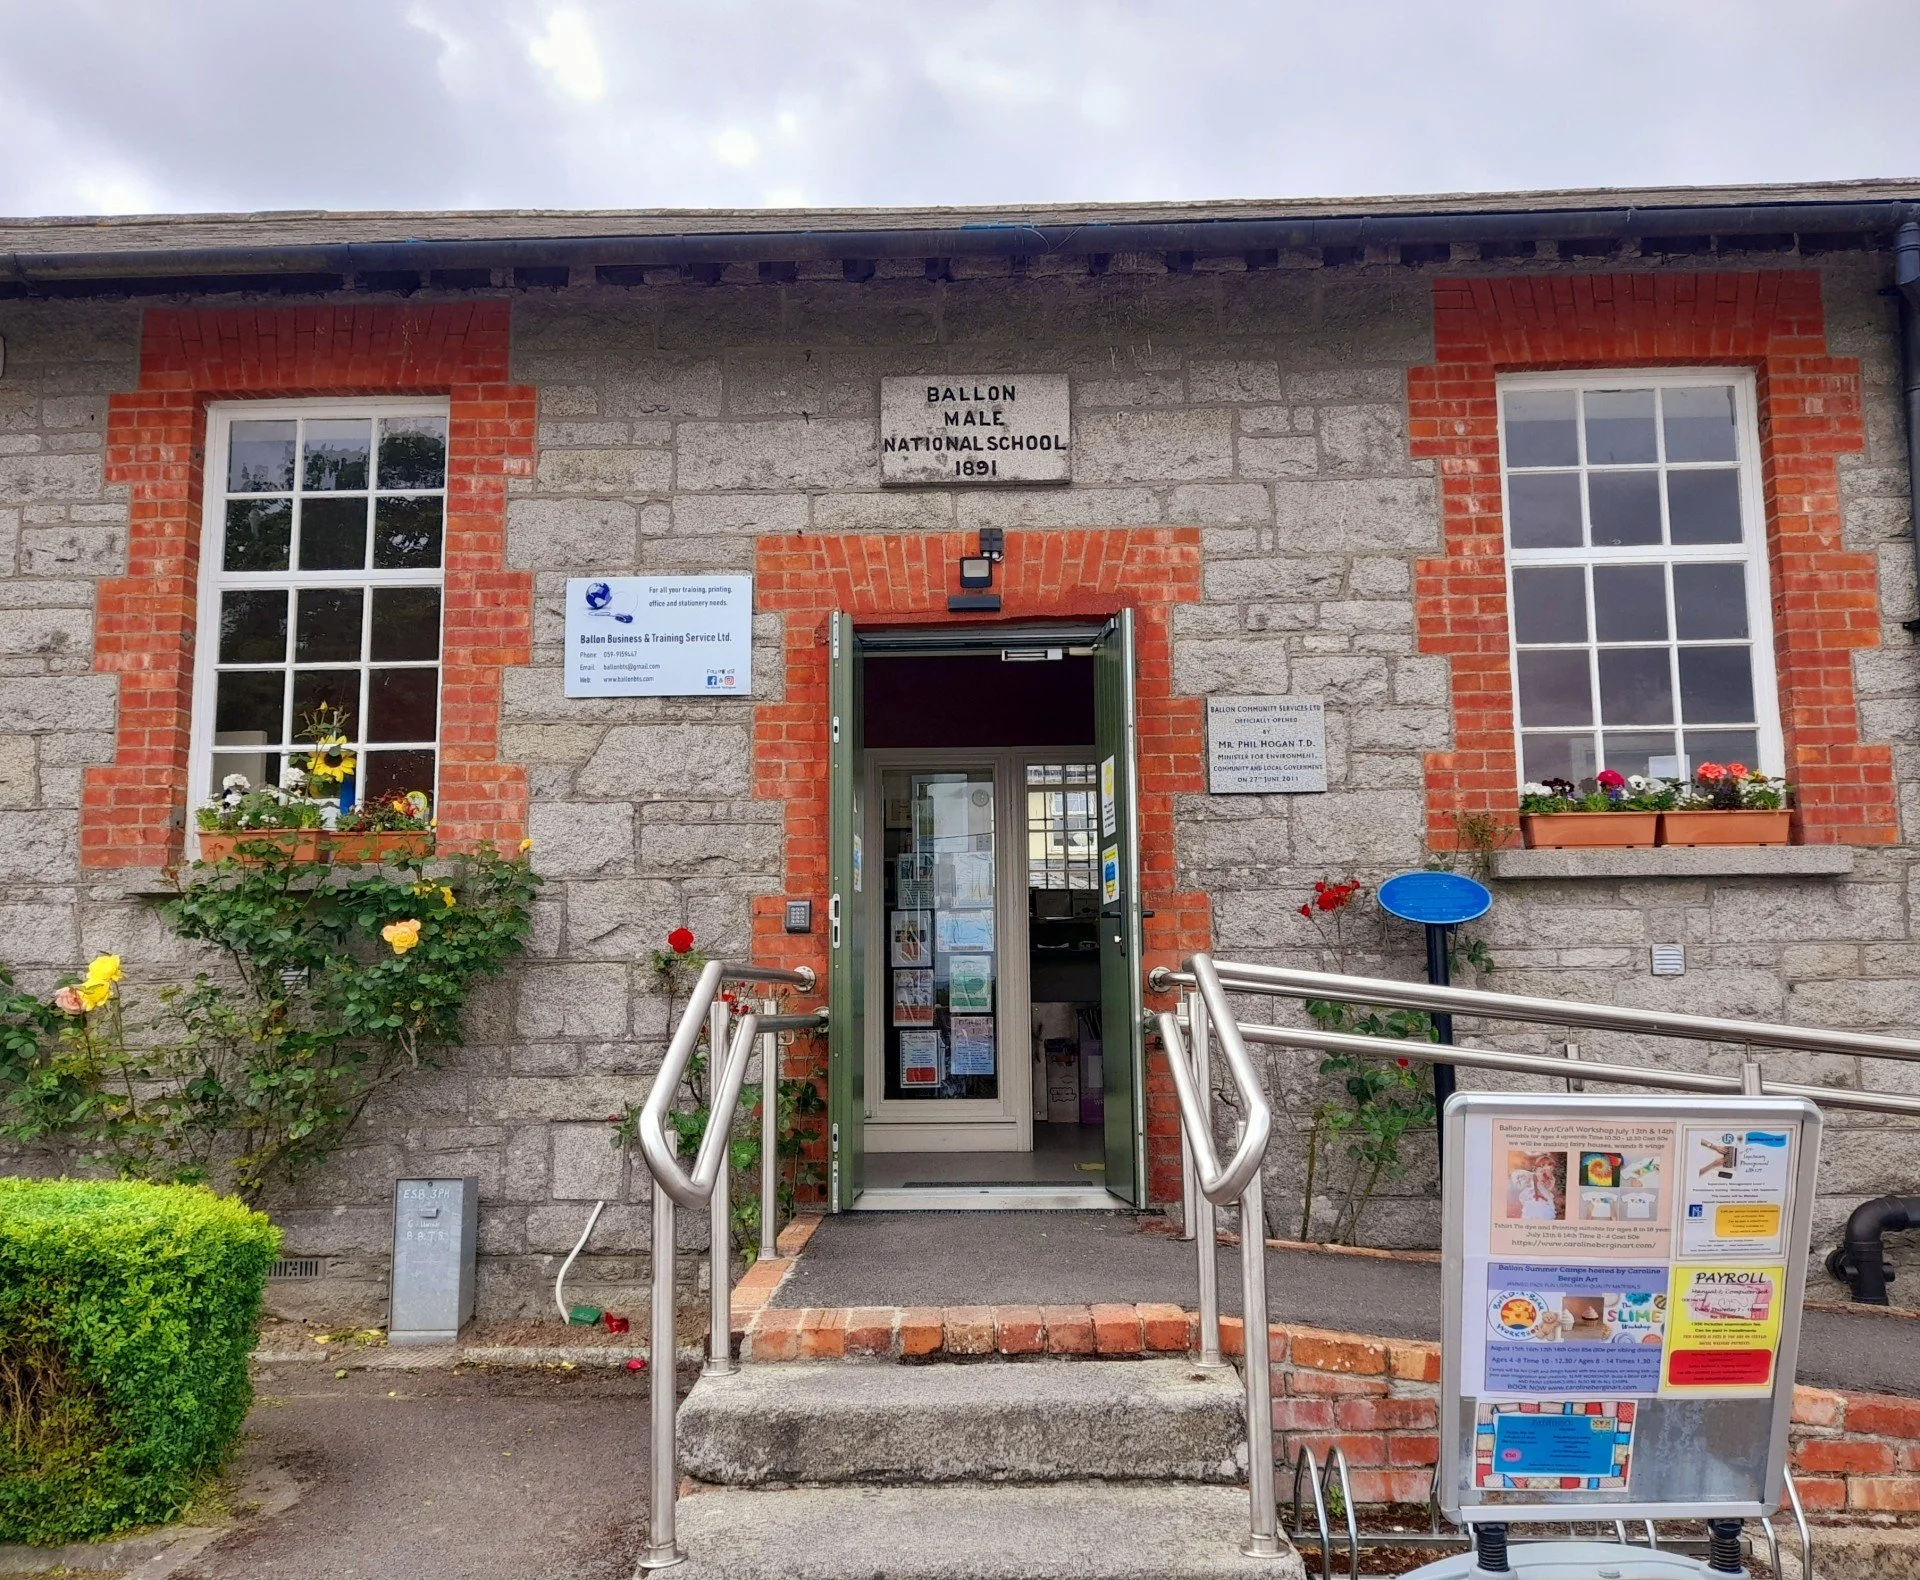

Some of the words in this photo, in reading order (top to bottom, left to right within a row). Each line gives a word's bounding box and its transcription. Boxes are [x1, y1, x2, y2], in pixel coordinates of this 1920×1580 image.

[927, 385, 1016, 402] BALLON
[944, 410, 1005, 427] MALE
[884, 436, 984, 453] NATIONAL
[987, 434, 1067, 451] SCHOOL
[955, 460, 998, 476] 1891
[649, 586, 658, 594] For
[660, 586, 668, 594] all
[678, 600, 708, 608] stationery
[580, 634, 606, 644] Ballon
[608, 634, 642, 644] Business
[644, 634, 650, 643] &
[652, 633, 684, 644] Training
[686, 632, 716, 642] Service
[718, 632, 732, 642] Ltd.
[603, 663, 661, 671] ballonbts@gmail.com
[1279, 704, 1308, 712] SERVICES
[1238, 740, 1258, 748] PHIL
[1260, 740, 1294, 748] HOGAN
[1298, 739, 1316, 747] T.D.
[1524, 1126, 1542, 1134] Fairy
[1576, 1126, 1614, 1135] Workshop
[404, 1188, 425, 1200] ESB
[430, 1188, 450, 1198] 3PH
[1552, 1224, 1578, 1232] Printing
[1512, 1240, 1656, 1250] https://www.carolineberginart.com/
[1498, 1264, 1523, 1272] Ballon
[1560, 1266, 1586, 1274] Camps
[1558, 1276, 1584, 1284] Bergin
[1696, 1272, 1766, 1284] PAYROLL
[1607, 1309, 1663, 1324] SLIME
